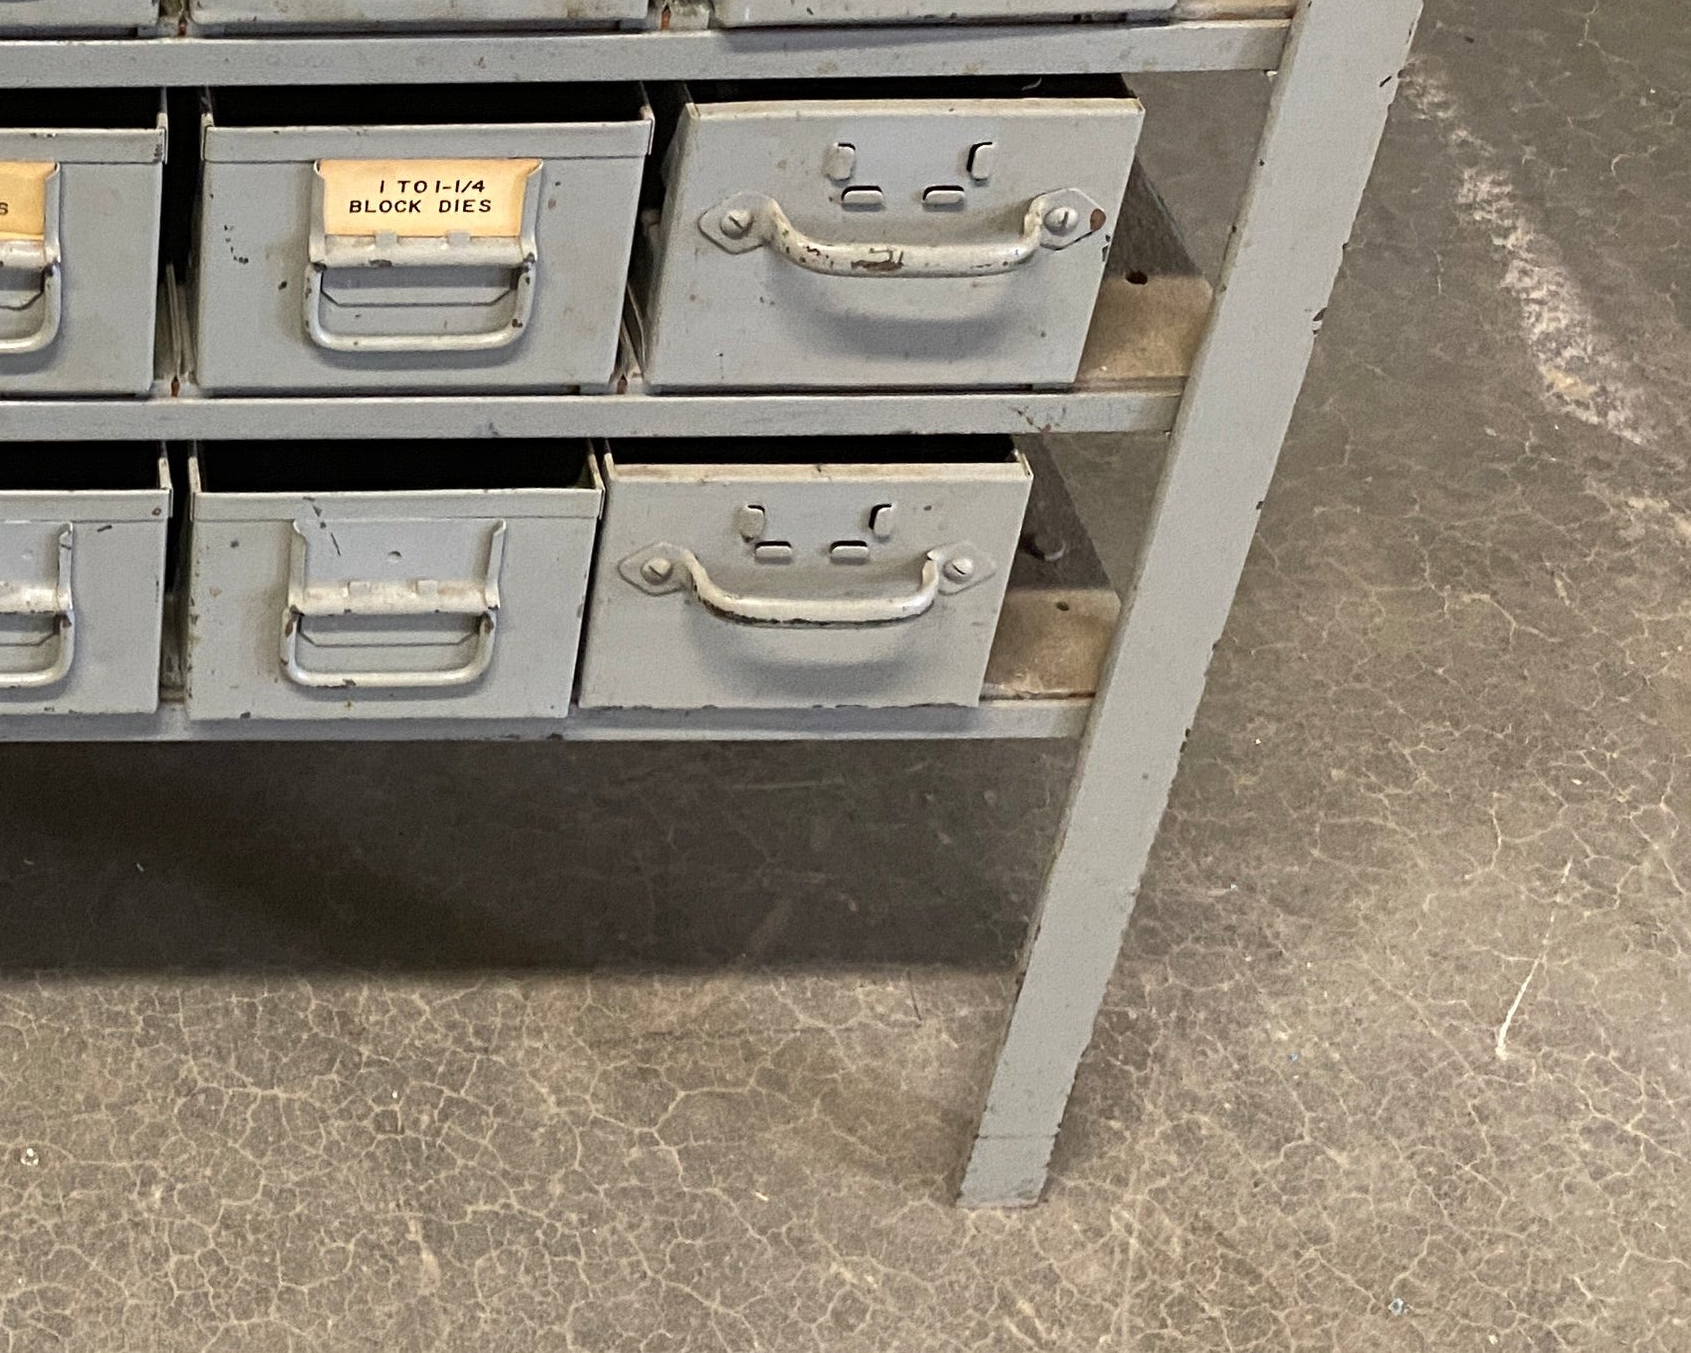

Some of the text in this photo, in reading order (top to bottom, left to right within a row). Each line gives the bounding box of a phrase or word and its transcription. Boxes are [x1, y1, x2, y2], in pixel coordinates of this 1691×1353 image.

[398, 180, 427, 193] TO
[435, 180, 485, 193] 1-1/4
[349, 200, 492, 214] BLOCK DIES
